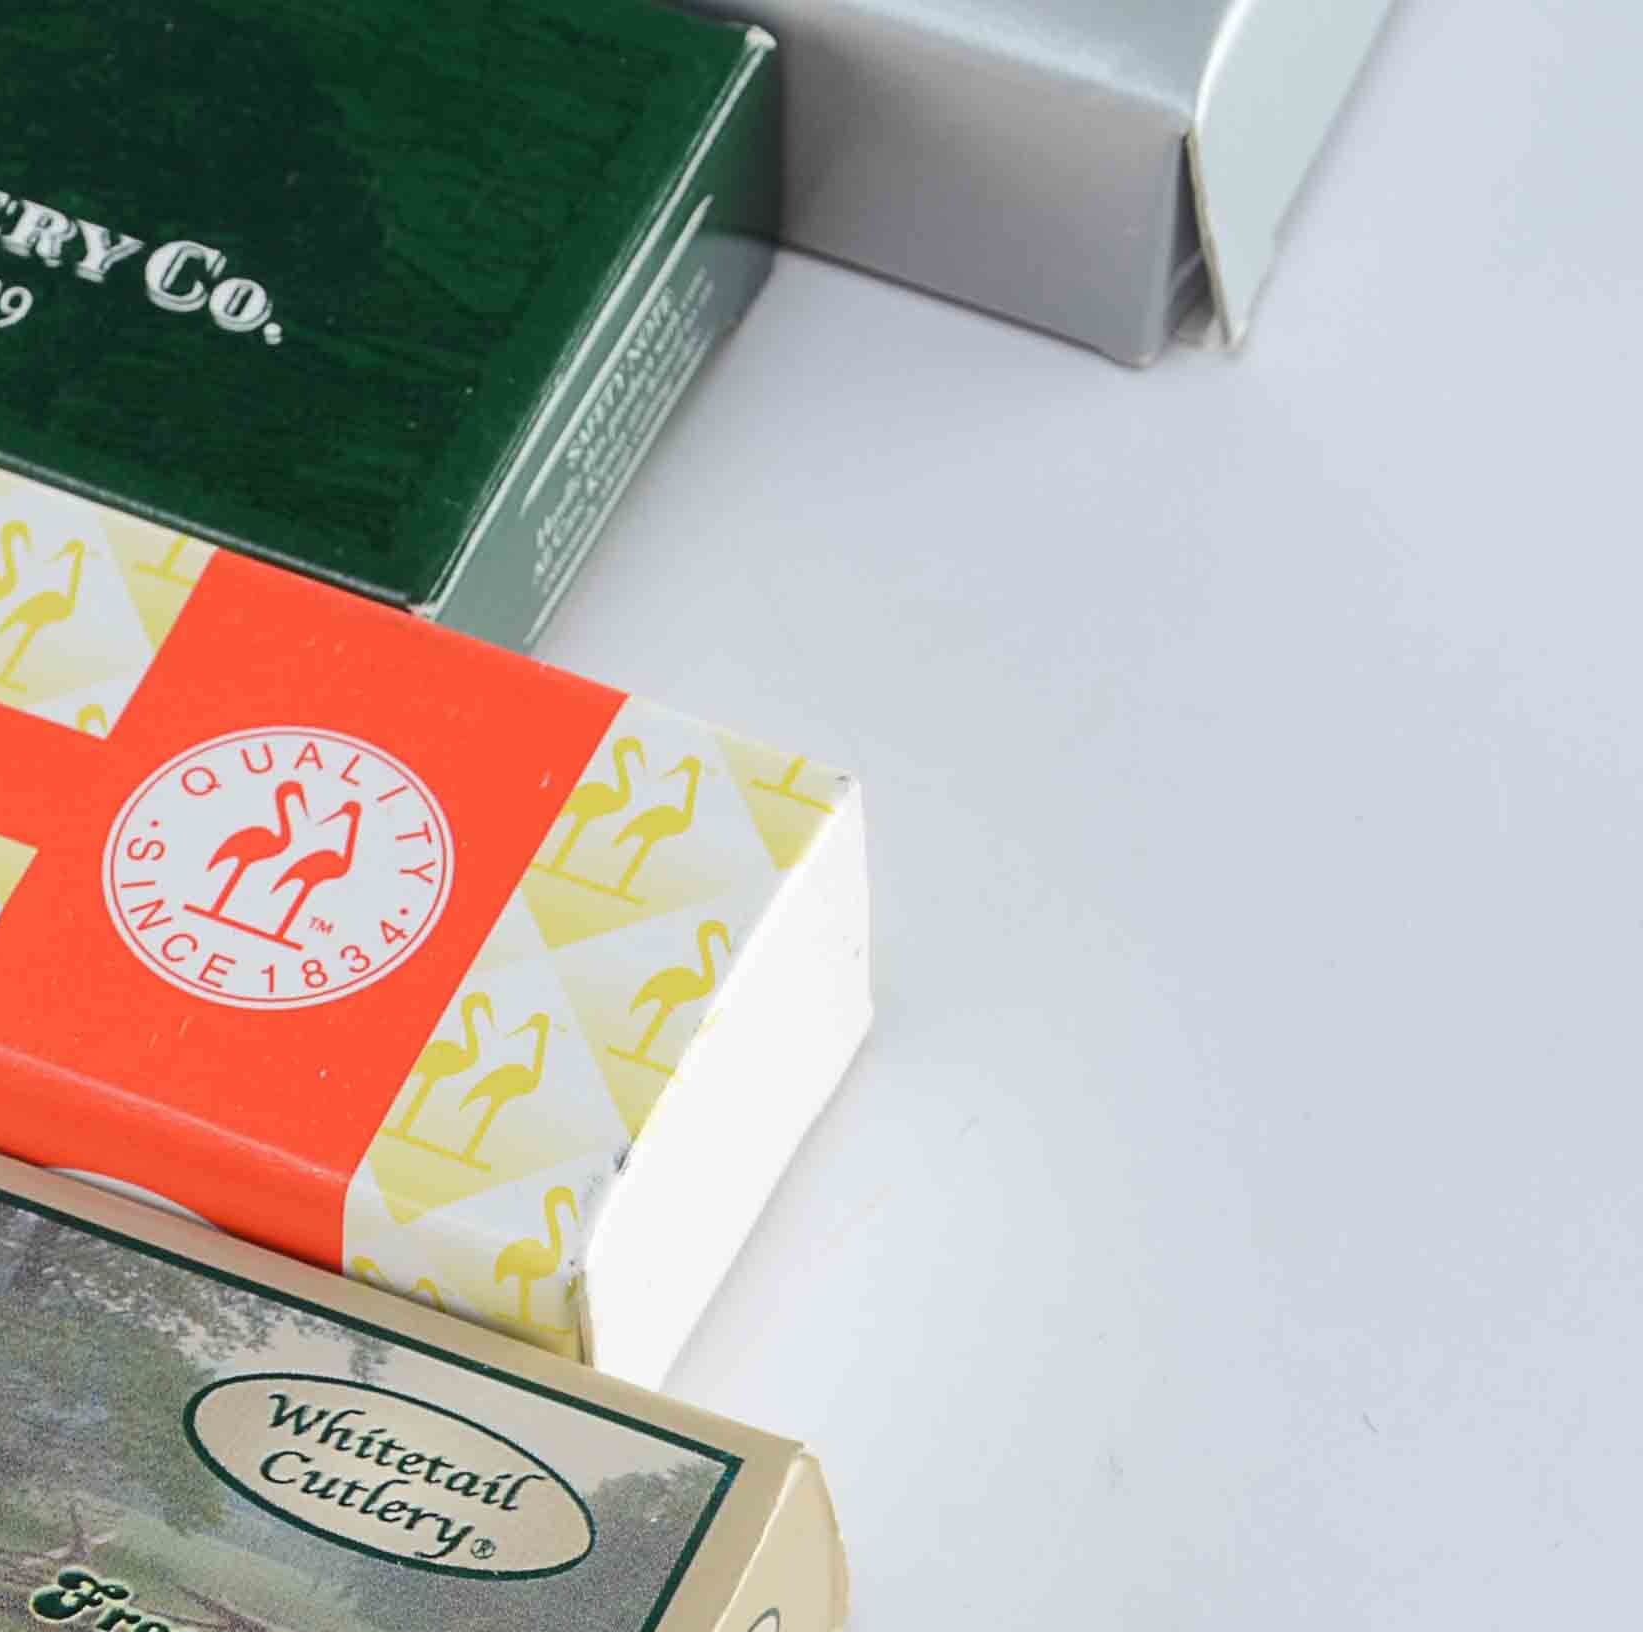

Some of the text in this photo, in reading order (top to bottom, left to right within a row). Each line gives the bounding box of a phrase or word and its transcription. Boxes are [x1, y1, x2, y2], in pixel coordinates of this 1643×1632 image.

[182, 742, 437, 885] QUALITY
[120, 835, 409, 994] SINCE 1834
[269, 1394, 547, 1512] Whitetail
